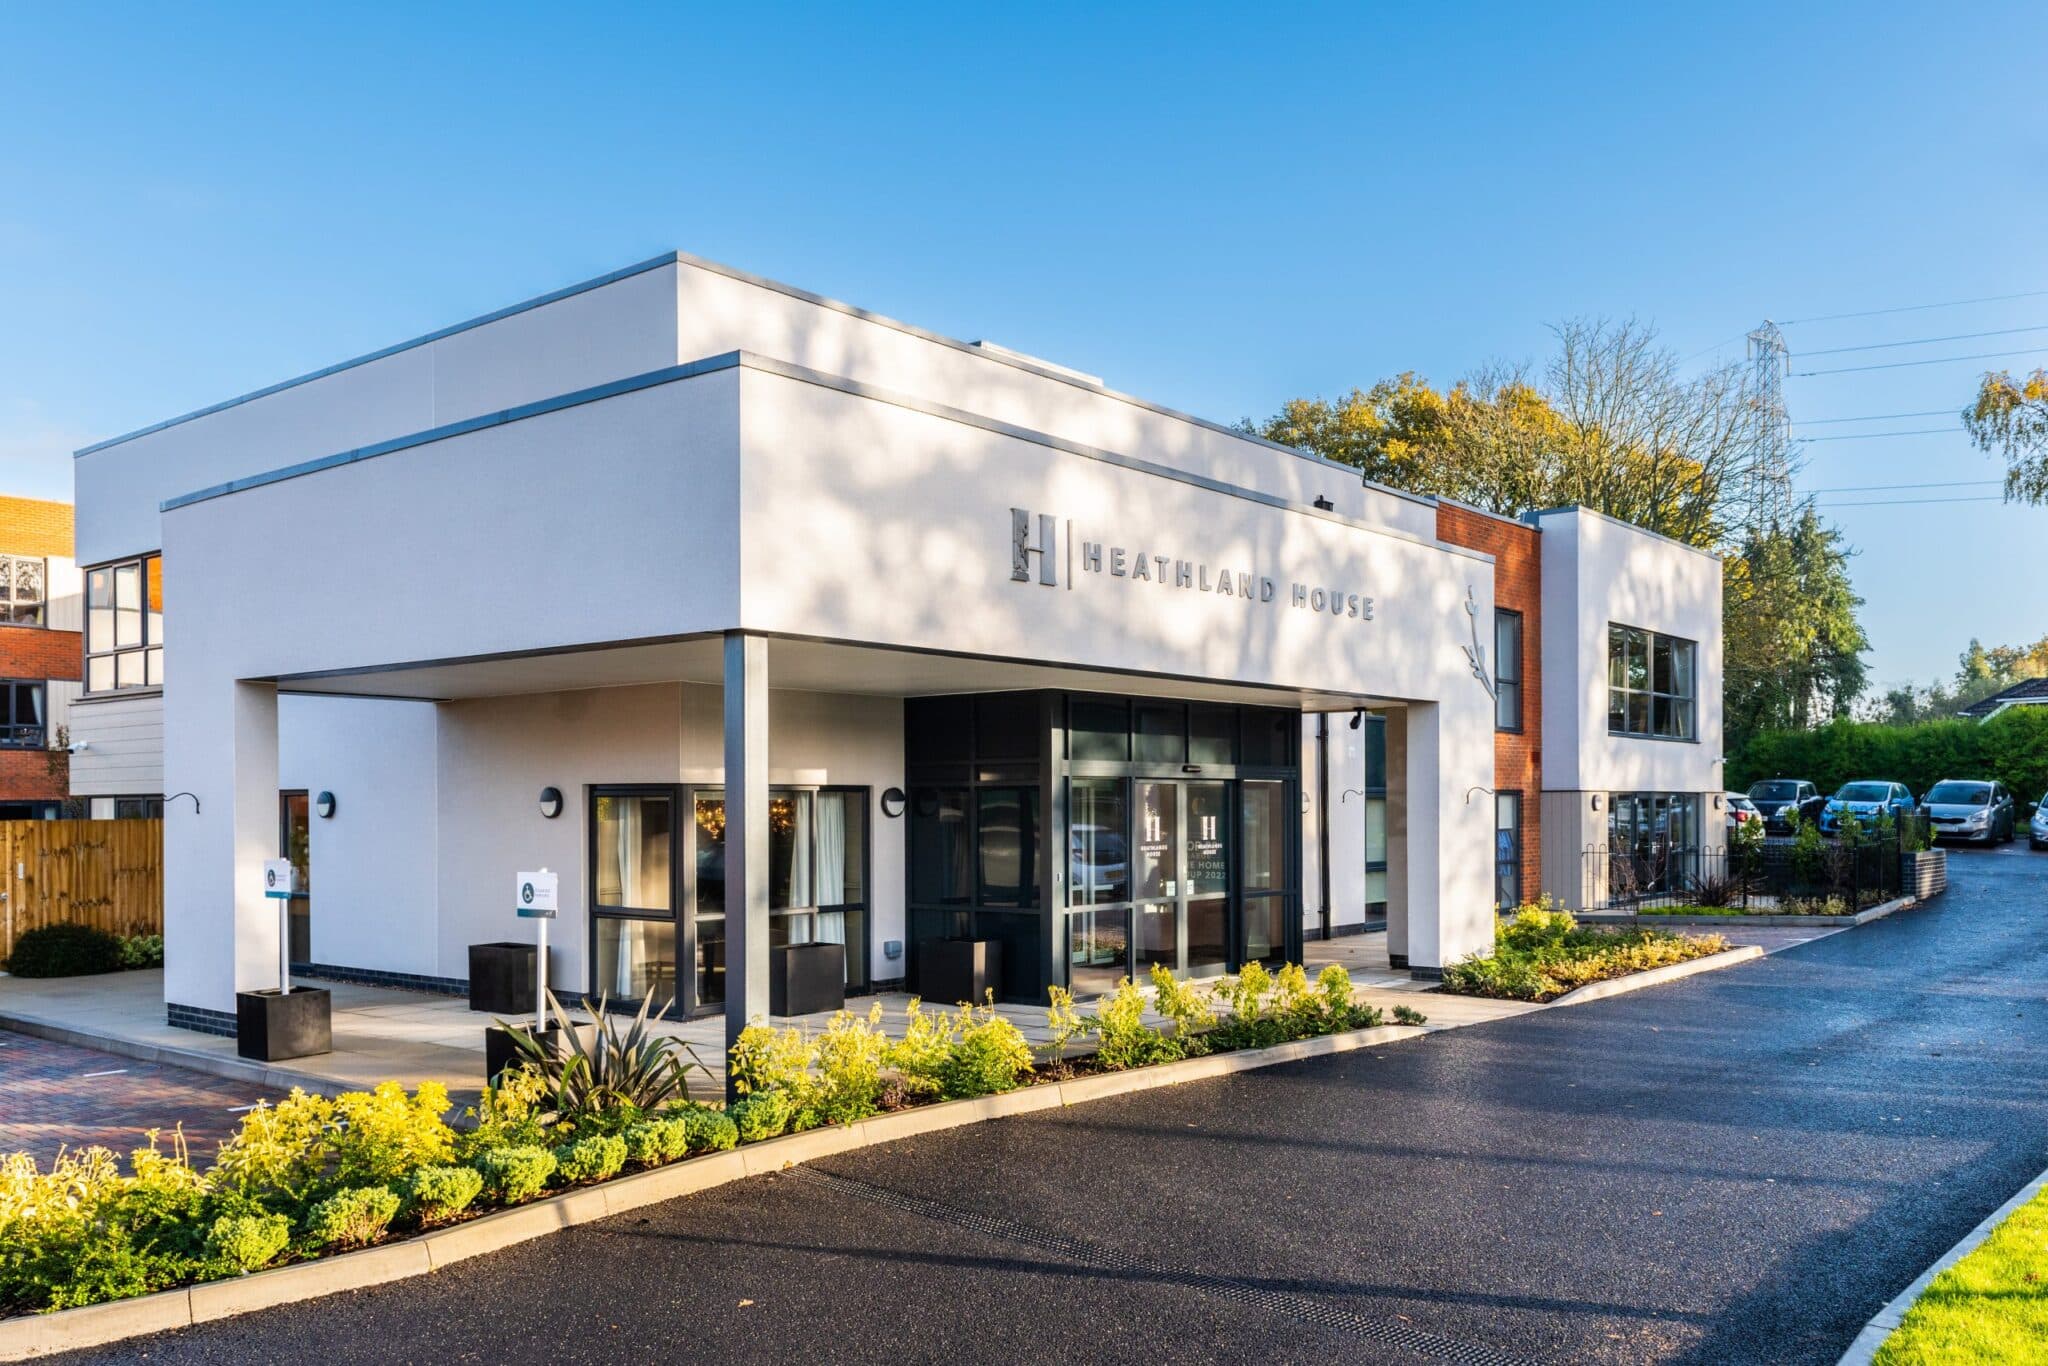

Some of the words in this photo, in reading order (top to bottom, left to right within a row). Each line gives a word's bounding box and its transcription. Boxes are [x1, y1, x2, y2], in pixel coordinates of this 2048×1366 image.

[1010, 507, 1057, 587] H
[1083, 541, 1275, 602] HEATHLAND
[1292, 583, 1375, 621] HOUSE
[1198, 860, 1225, 870] HOME
